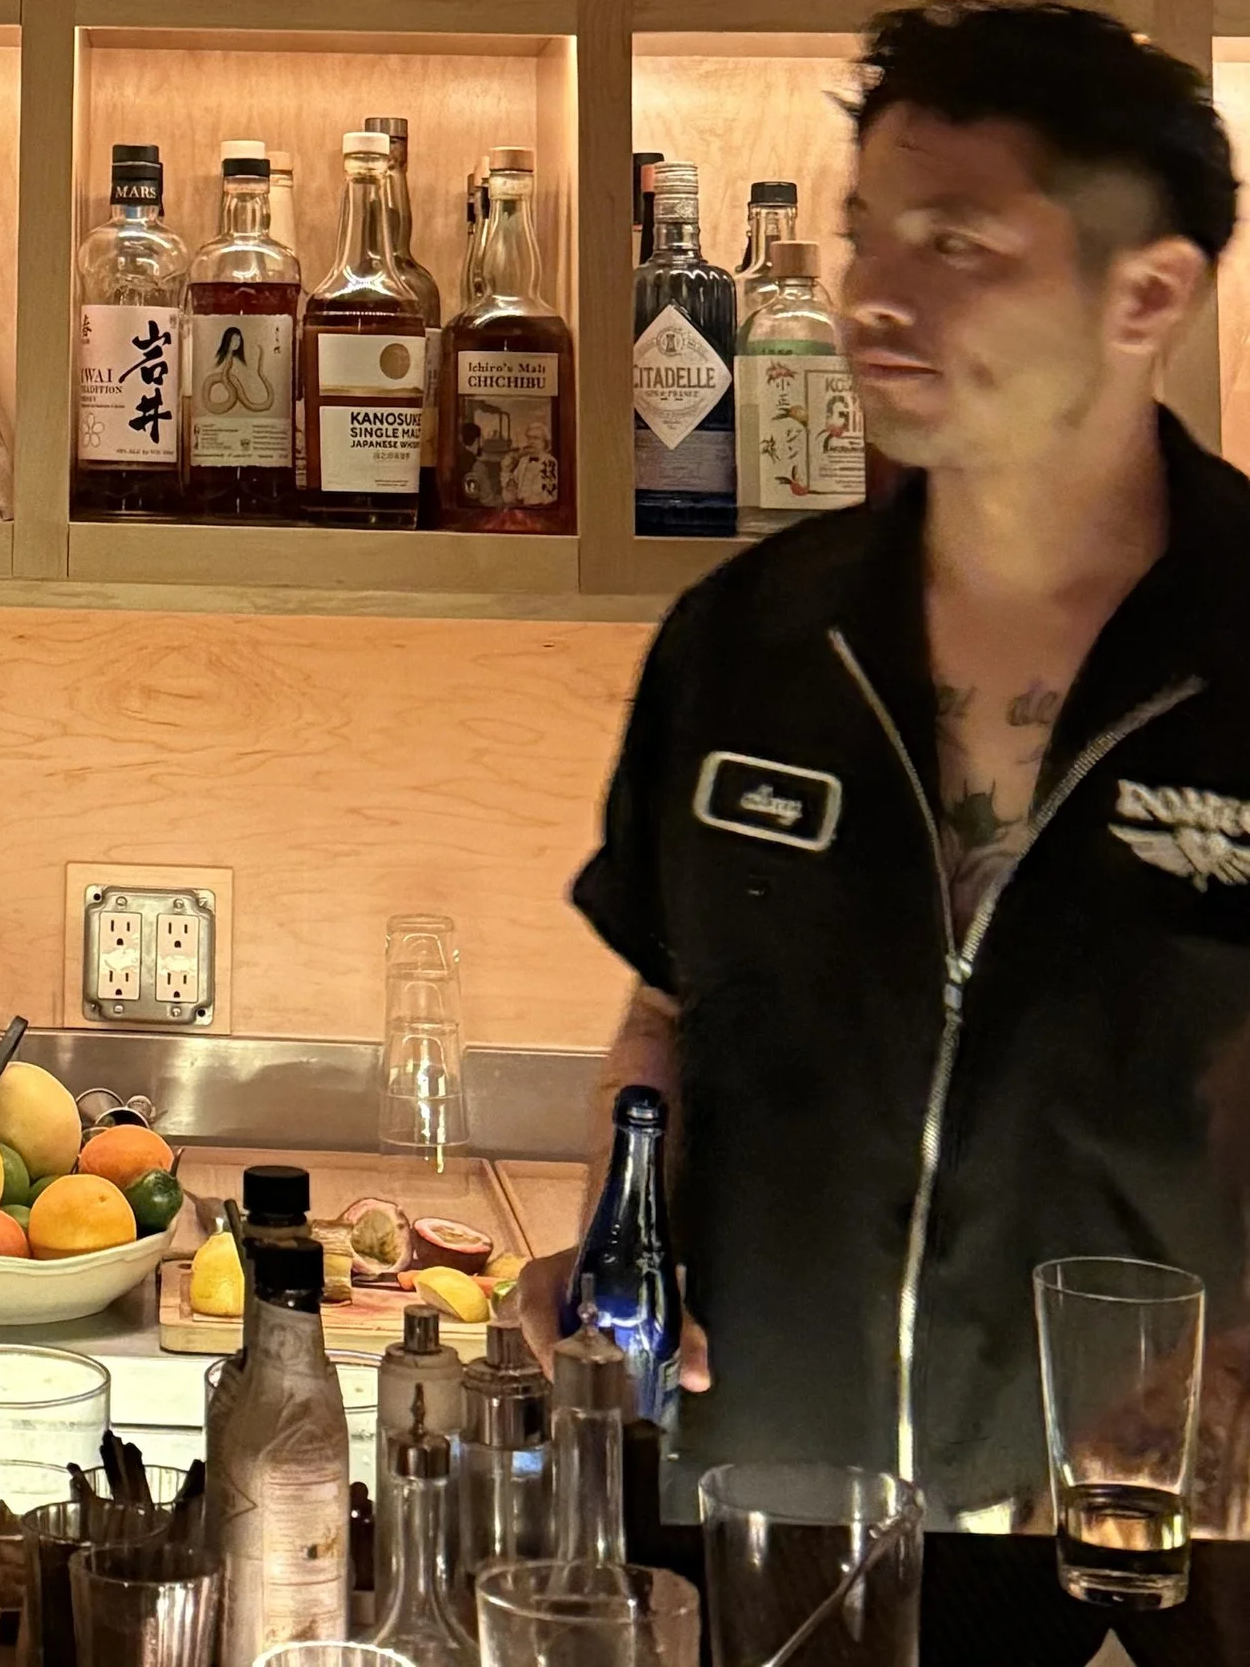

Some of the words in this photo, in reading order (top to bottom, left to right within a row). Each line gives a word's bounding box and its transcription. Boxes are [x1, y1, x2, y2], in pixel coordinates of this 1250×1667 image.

[115, 185, 157, 199] MARS
[468, 375, 546, 390] CHICHIBU
[350, 427, 398, 439] SINGLE
[350, 440, 398, 449] JAPANESE
